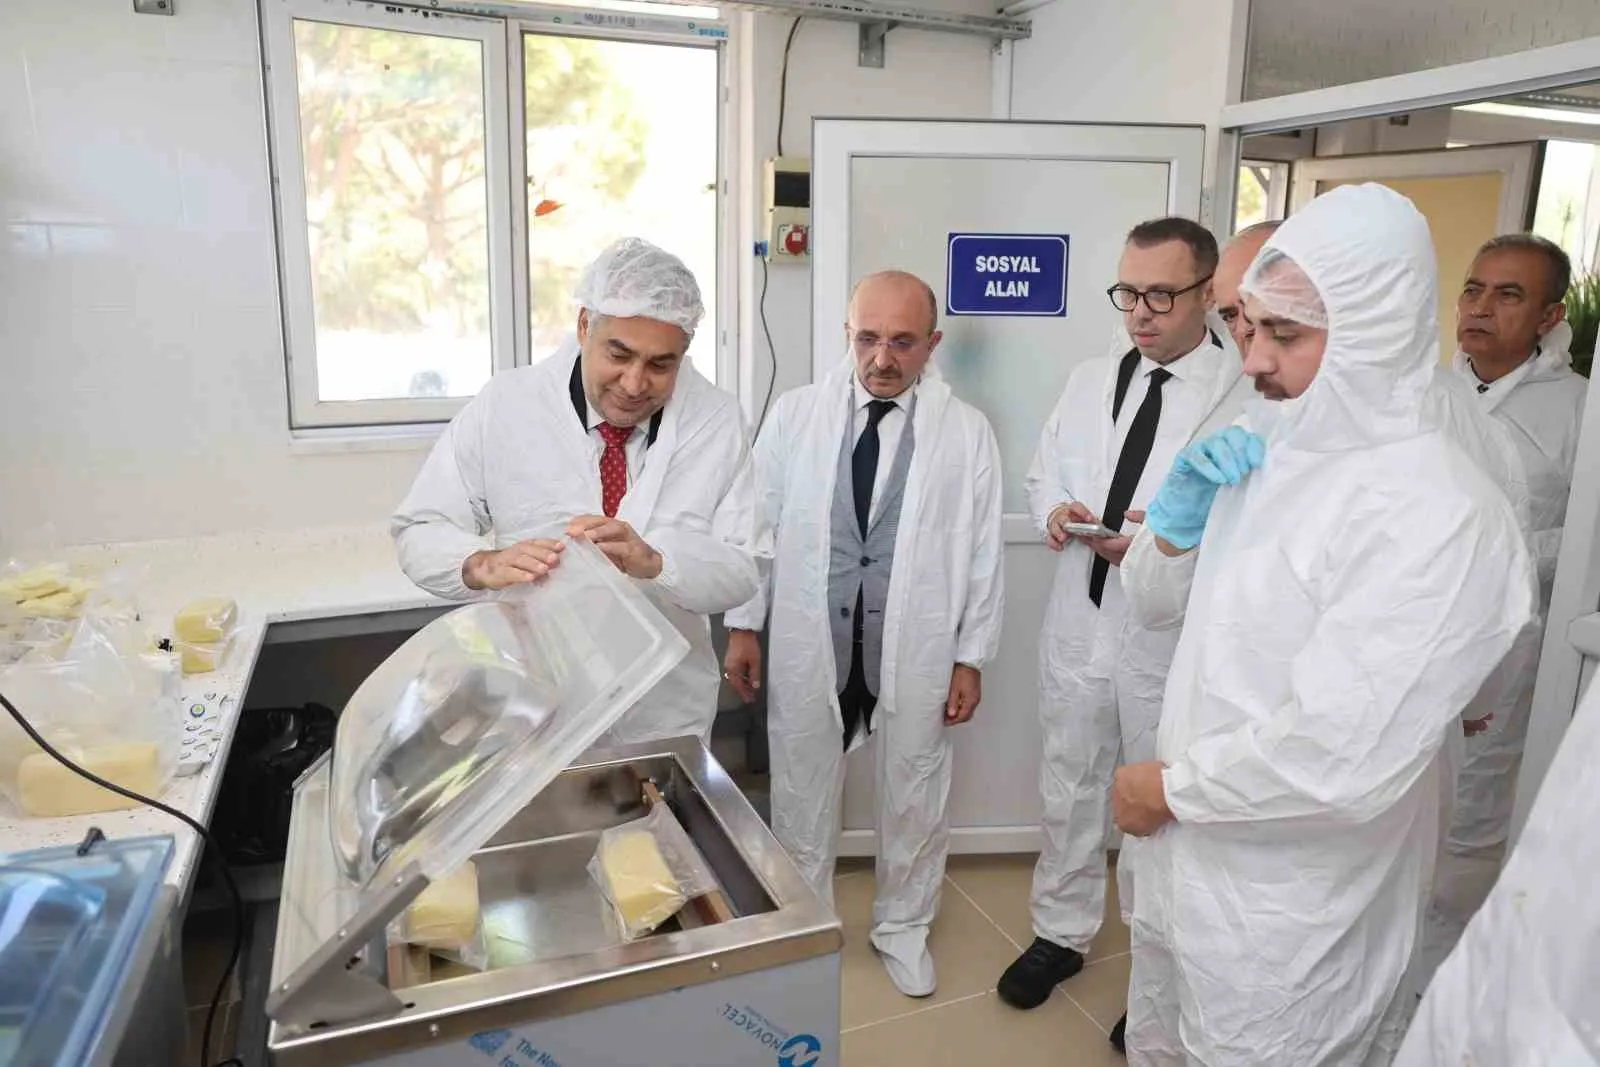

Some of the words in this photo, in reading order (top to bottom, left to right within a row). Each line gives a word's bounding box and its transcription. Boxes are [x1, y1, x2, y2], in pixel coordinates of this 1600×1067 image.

[975, 255, 1041, 273] SOSYAL
[984, 280, 1030, 297] ALAN
[721, 1003, 783, 1050] NOVACEL
[516, 1038, 538, 1059] The
